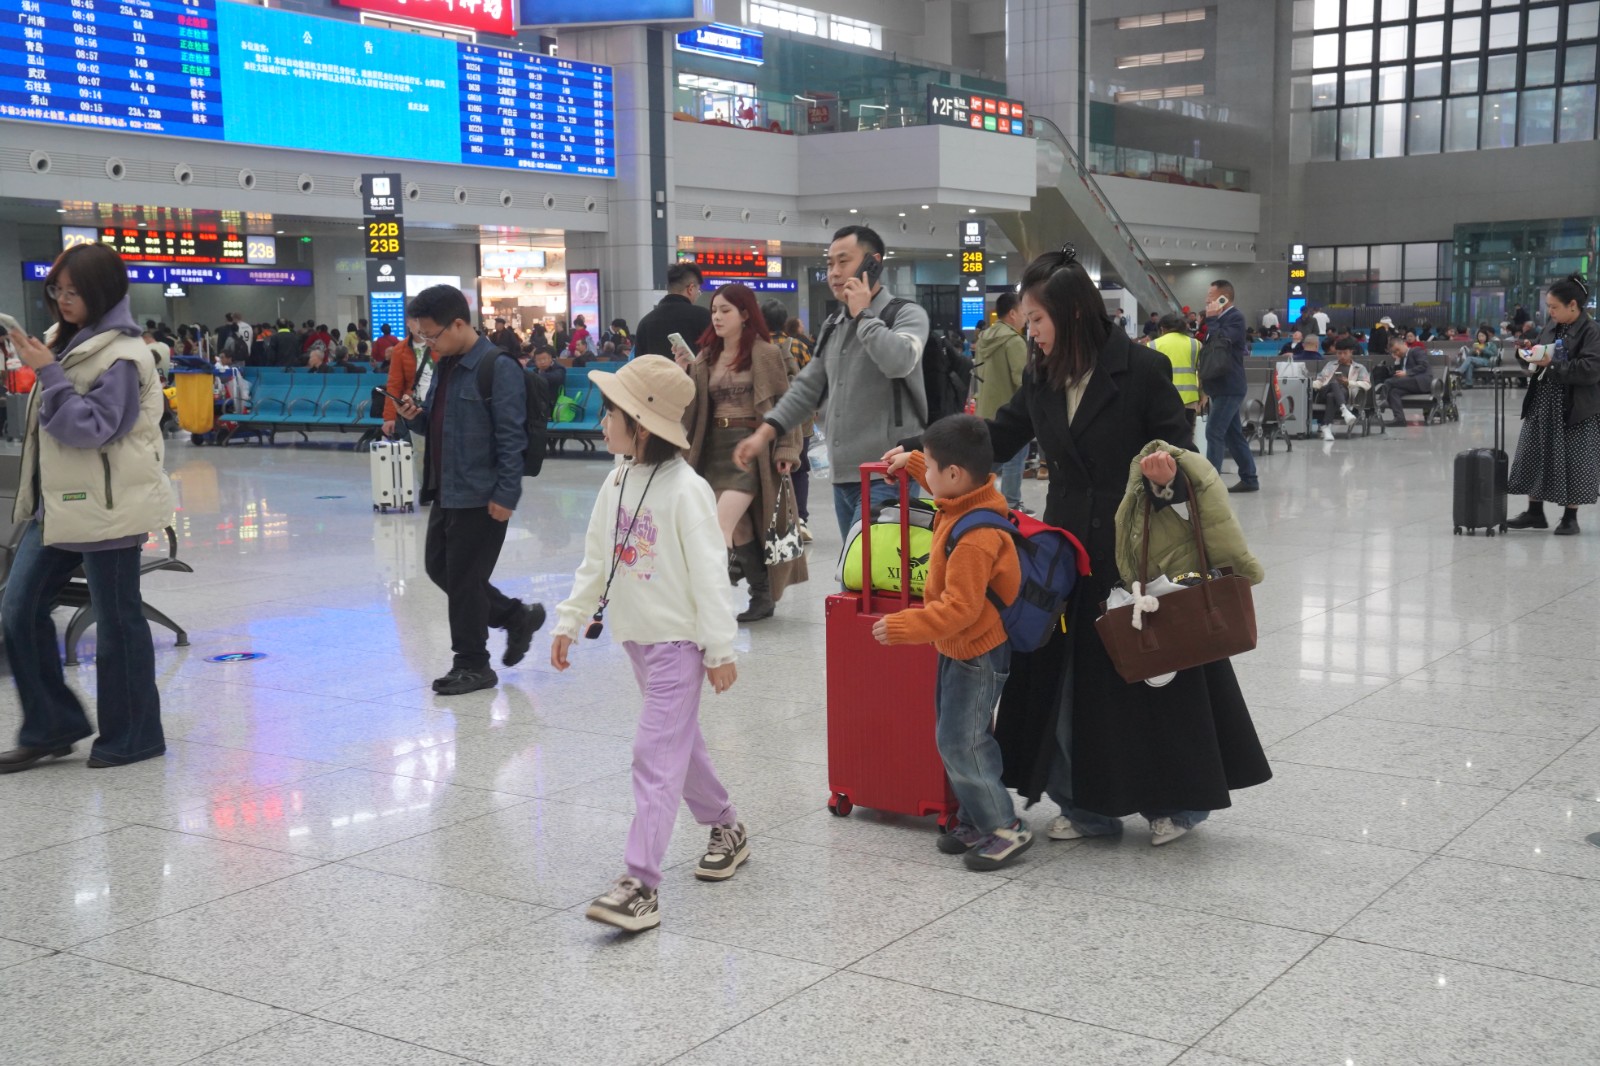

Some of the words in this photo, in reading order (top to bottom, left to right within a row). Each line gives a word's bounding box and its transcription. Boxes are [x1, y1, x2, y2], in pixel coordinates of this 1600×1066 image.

[18, 14, 46, 27] 广州南
[72, 10, 95, 22] 08:49
[179, 26, 208, 40] 正在检票
[74, 23, 96, 35] 08:52
[133, 33, 146, 43] 17A
[180, 39, 209, 52] 正在检票
[303, 31, 312, 44] 公
[364, 40, 373, 54] 告
[25, 41, 44, 53] 青岛
[75, 36, 97, 48] 08:56
[181, 51, 210, 64] 正在检票
[76, 49, 98, 60] 08:57
[181, 64, 211, 76] 正在检票
[28, 68, 46, 80] 武汉
[77, 63, 100, 74] 09:02
[24, 80, 52, 94] 石柱县
[78, 76, 100, 86] 09:07
[30, 94, 48, 107] 秀山
[79, 88, 102, 99] 09:14
[139, 96, 149, 106] 7A
[80, 102, 103, 112] 09:15
[940, 98, 952, 116] 2F
[370, 198, 395, 206] 检票口
[370, 223, 398, 236] 22B
[249, 242, 274, 258] 23B
[370, 239, 399, 252] 23B
[963, 252, 982, 261] 24B
[963, 263, 982, 272] 25B
